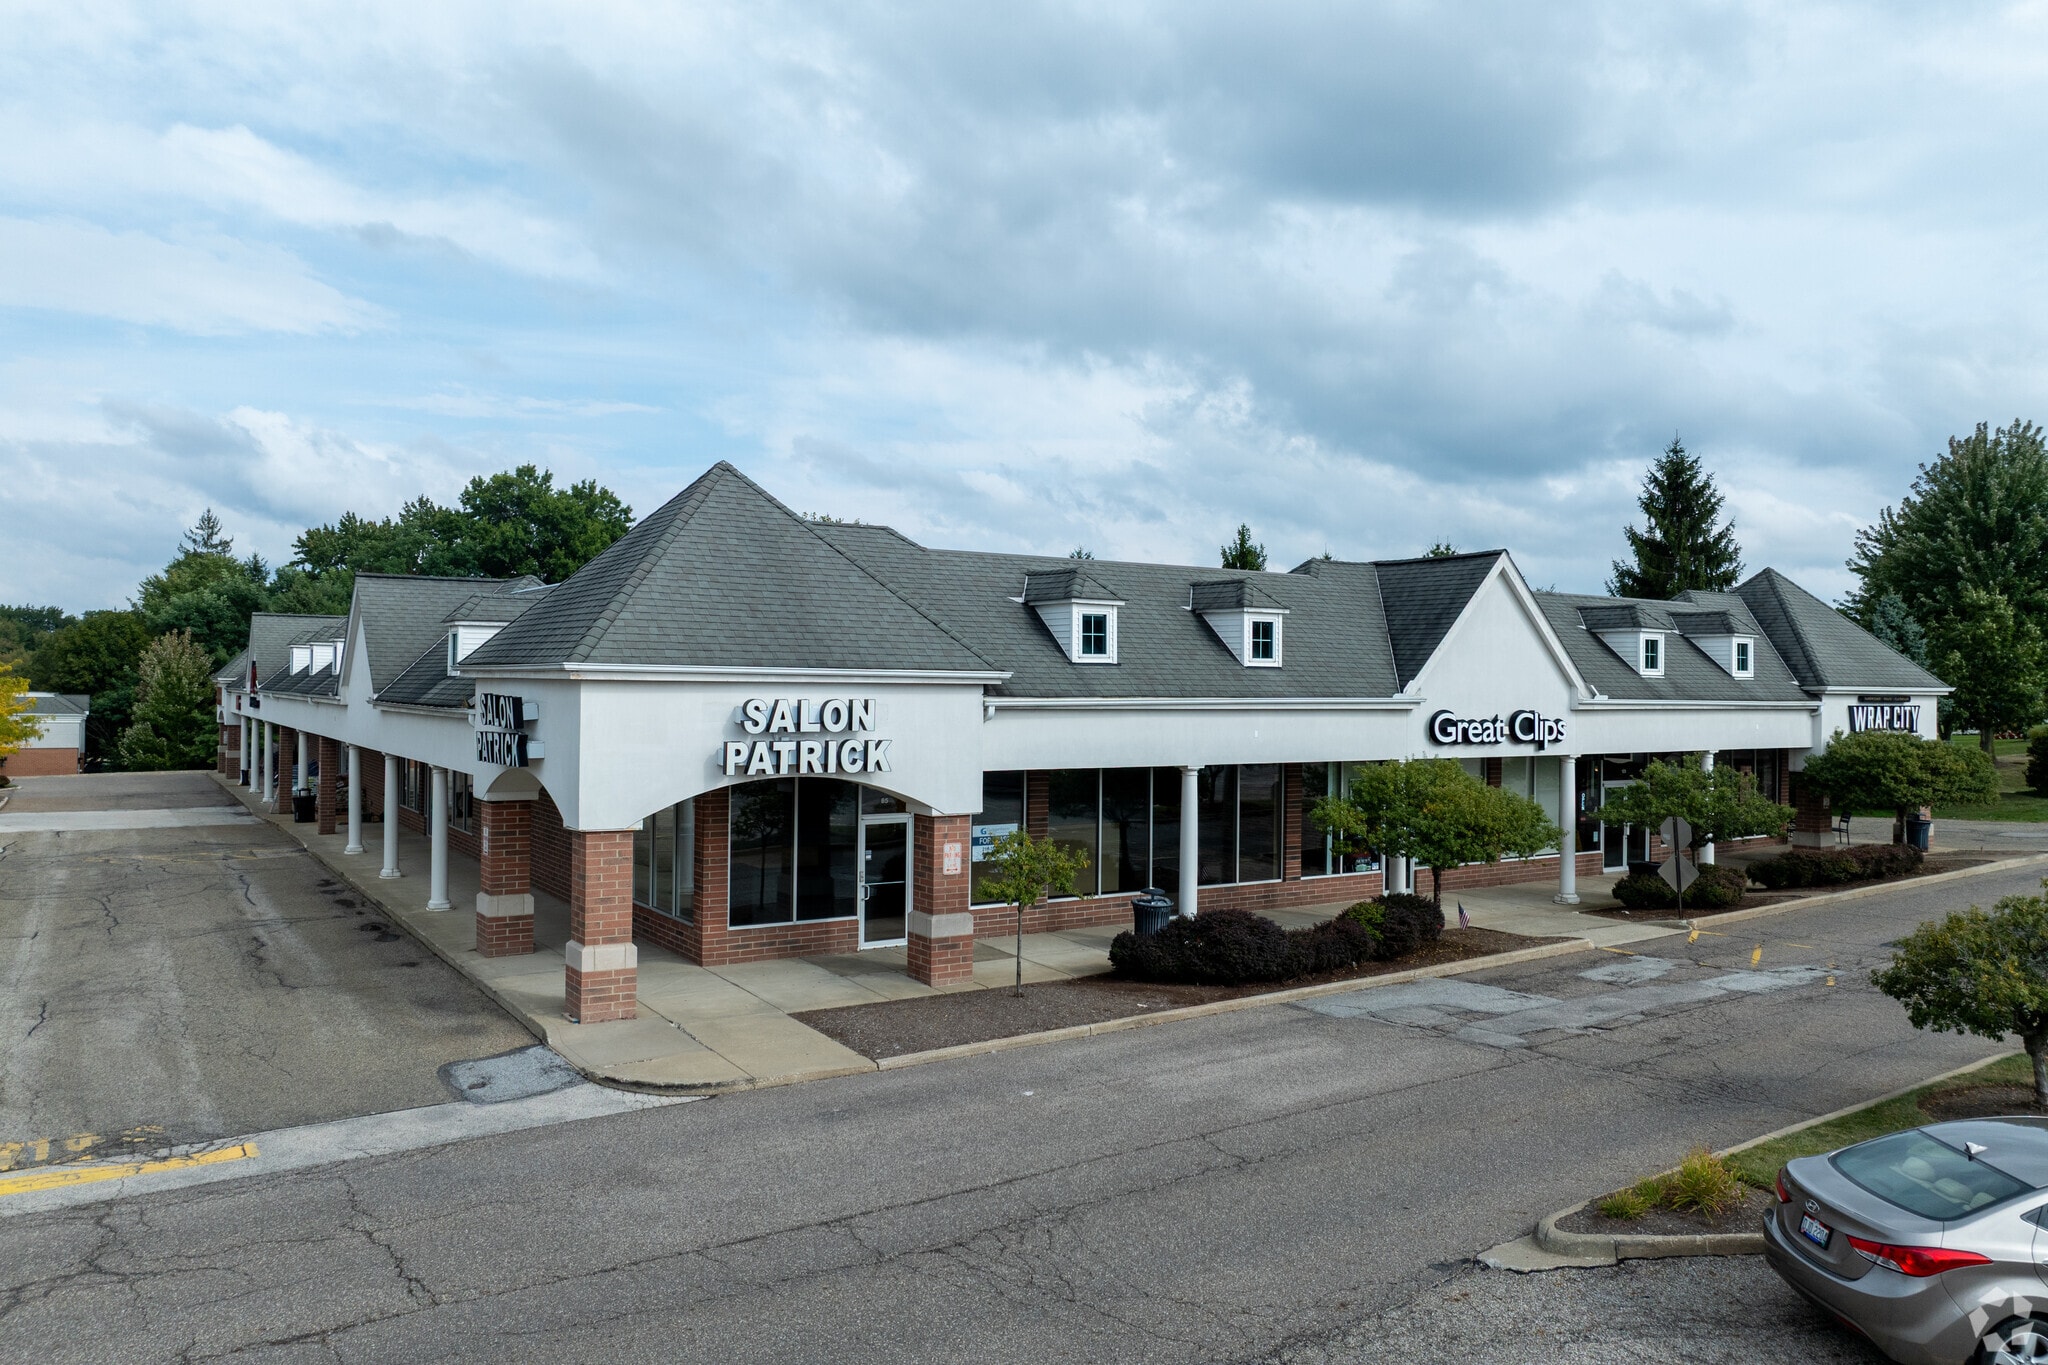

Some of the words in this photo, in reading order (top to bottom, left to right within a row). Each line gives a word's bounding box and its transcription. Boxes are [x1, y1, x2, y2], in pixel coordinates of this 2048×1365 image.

[480, 692, 519, 729] SALON
[742, 698, 877, 734] SALON
[1853, 706, 1890, 732] WRAP
[1893, 706, 1919, 731] CITY
[1430, 710, 1505, 745] Great
[1509, 710, 1567, 750] Clips
[476, 731, 524, 768] PATRICK
[723, 739, 893, 776] PATRICK
